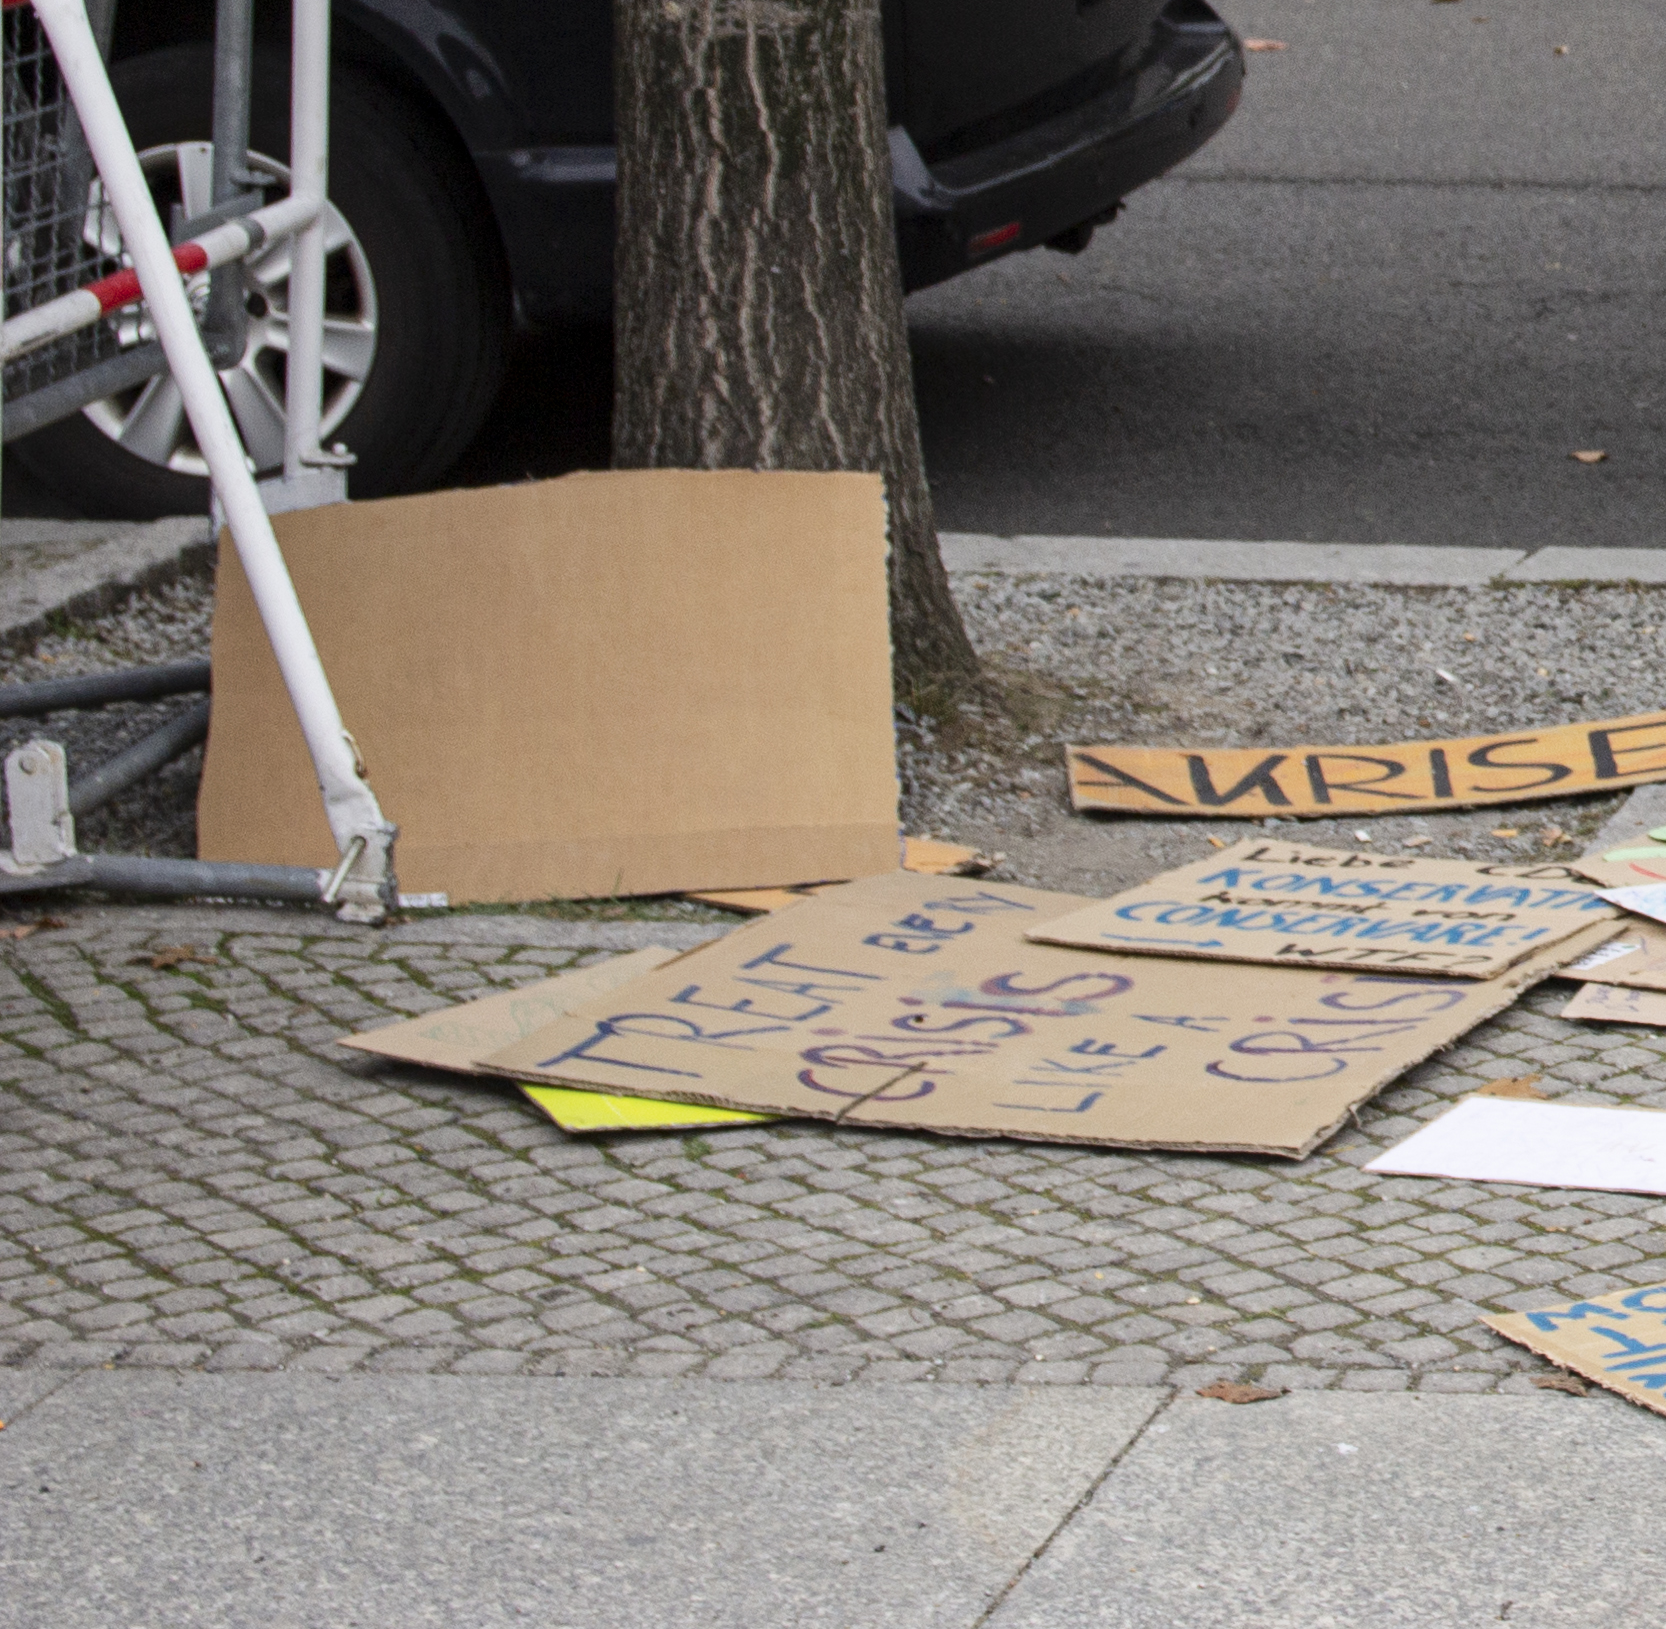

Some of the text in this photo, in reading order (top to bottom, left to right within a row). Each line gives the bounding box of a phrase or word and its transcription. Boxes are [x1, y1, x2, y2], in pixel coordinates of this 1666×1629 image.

[1243, 845, 1592, 888] Liebe CD
[1411, 907, 1517, 922] von
[536, 942, 888, 1078] TREAT
[991, 1038, 1169, 1113] LIKE
